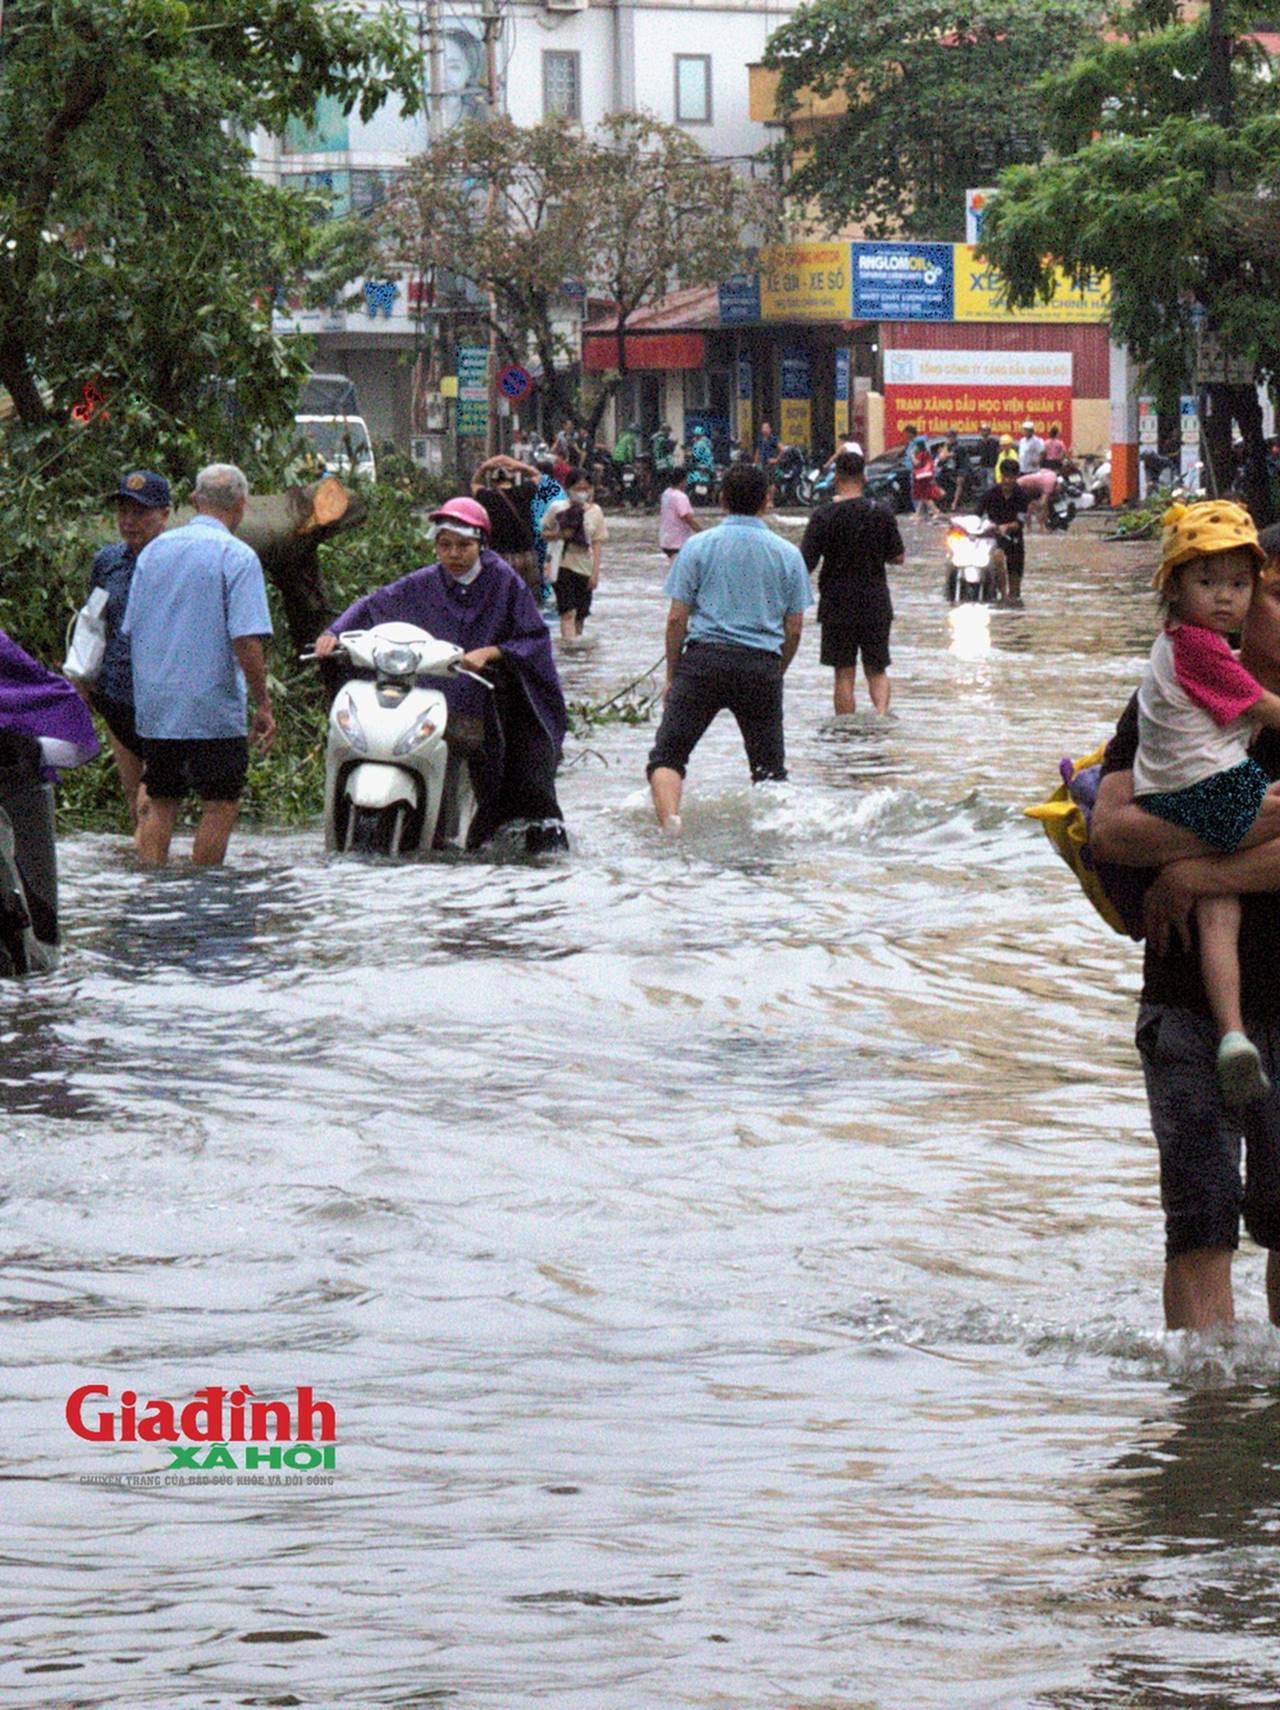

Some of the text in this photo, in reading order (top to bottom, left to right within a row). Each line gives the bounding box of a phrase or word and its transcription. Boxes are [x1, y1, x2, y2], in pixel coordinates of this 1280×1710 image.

[895, 397, 922, 414] TRẠM
[924, 396, 952, 412] XĂNG
[955, 393, 976, 412] DẦU
[978, 398, 1000, 414] HỌC
